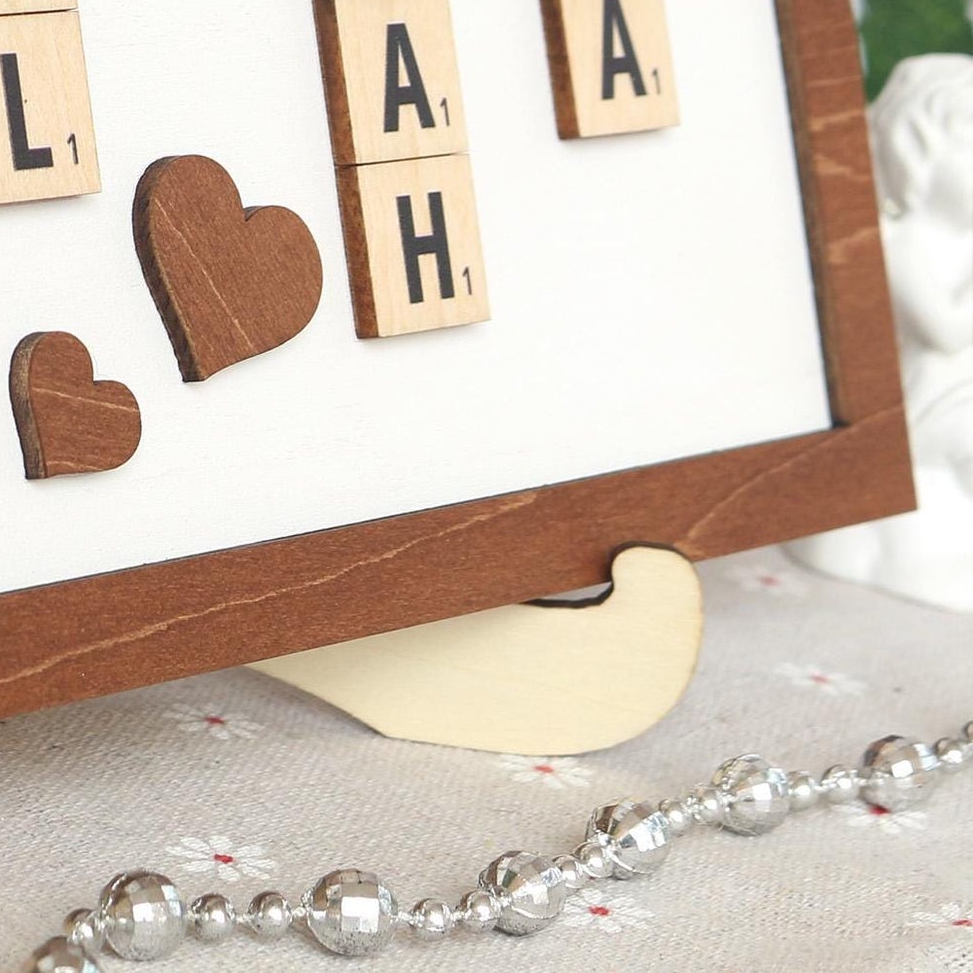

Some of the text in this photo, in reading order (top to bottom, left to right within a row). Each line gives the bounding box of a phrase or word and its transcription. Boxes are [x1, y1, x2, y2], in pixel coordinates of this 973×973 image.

[651, 68, 661, 95] 1
[439, 97, 450, 127] 1
[66, 133, 79, 165] 1
[462, 266, 473, 296] 1
